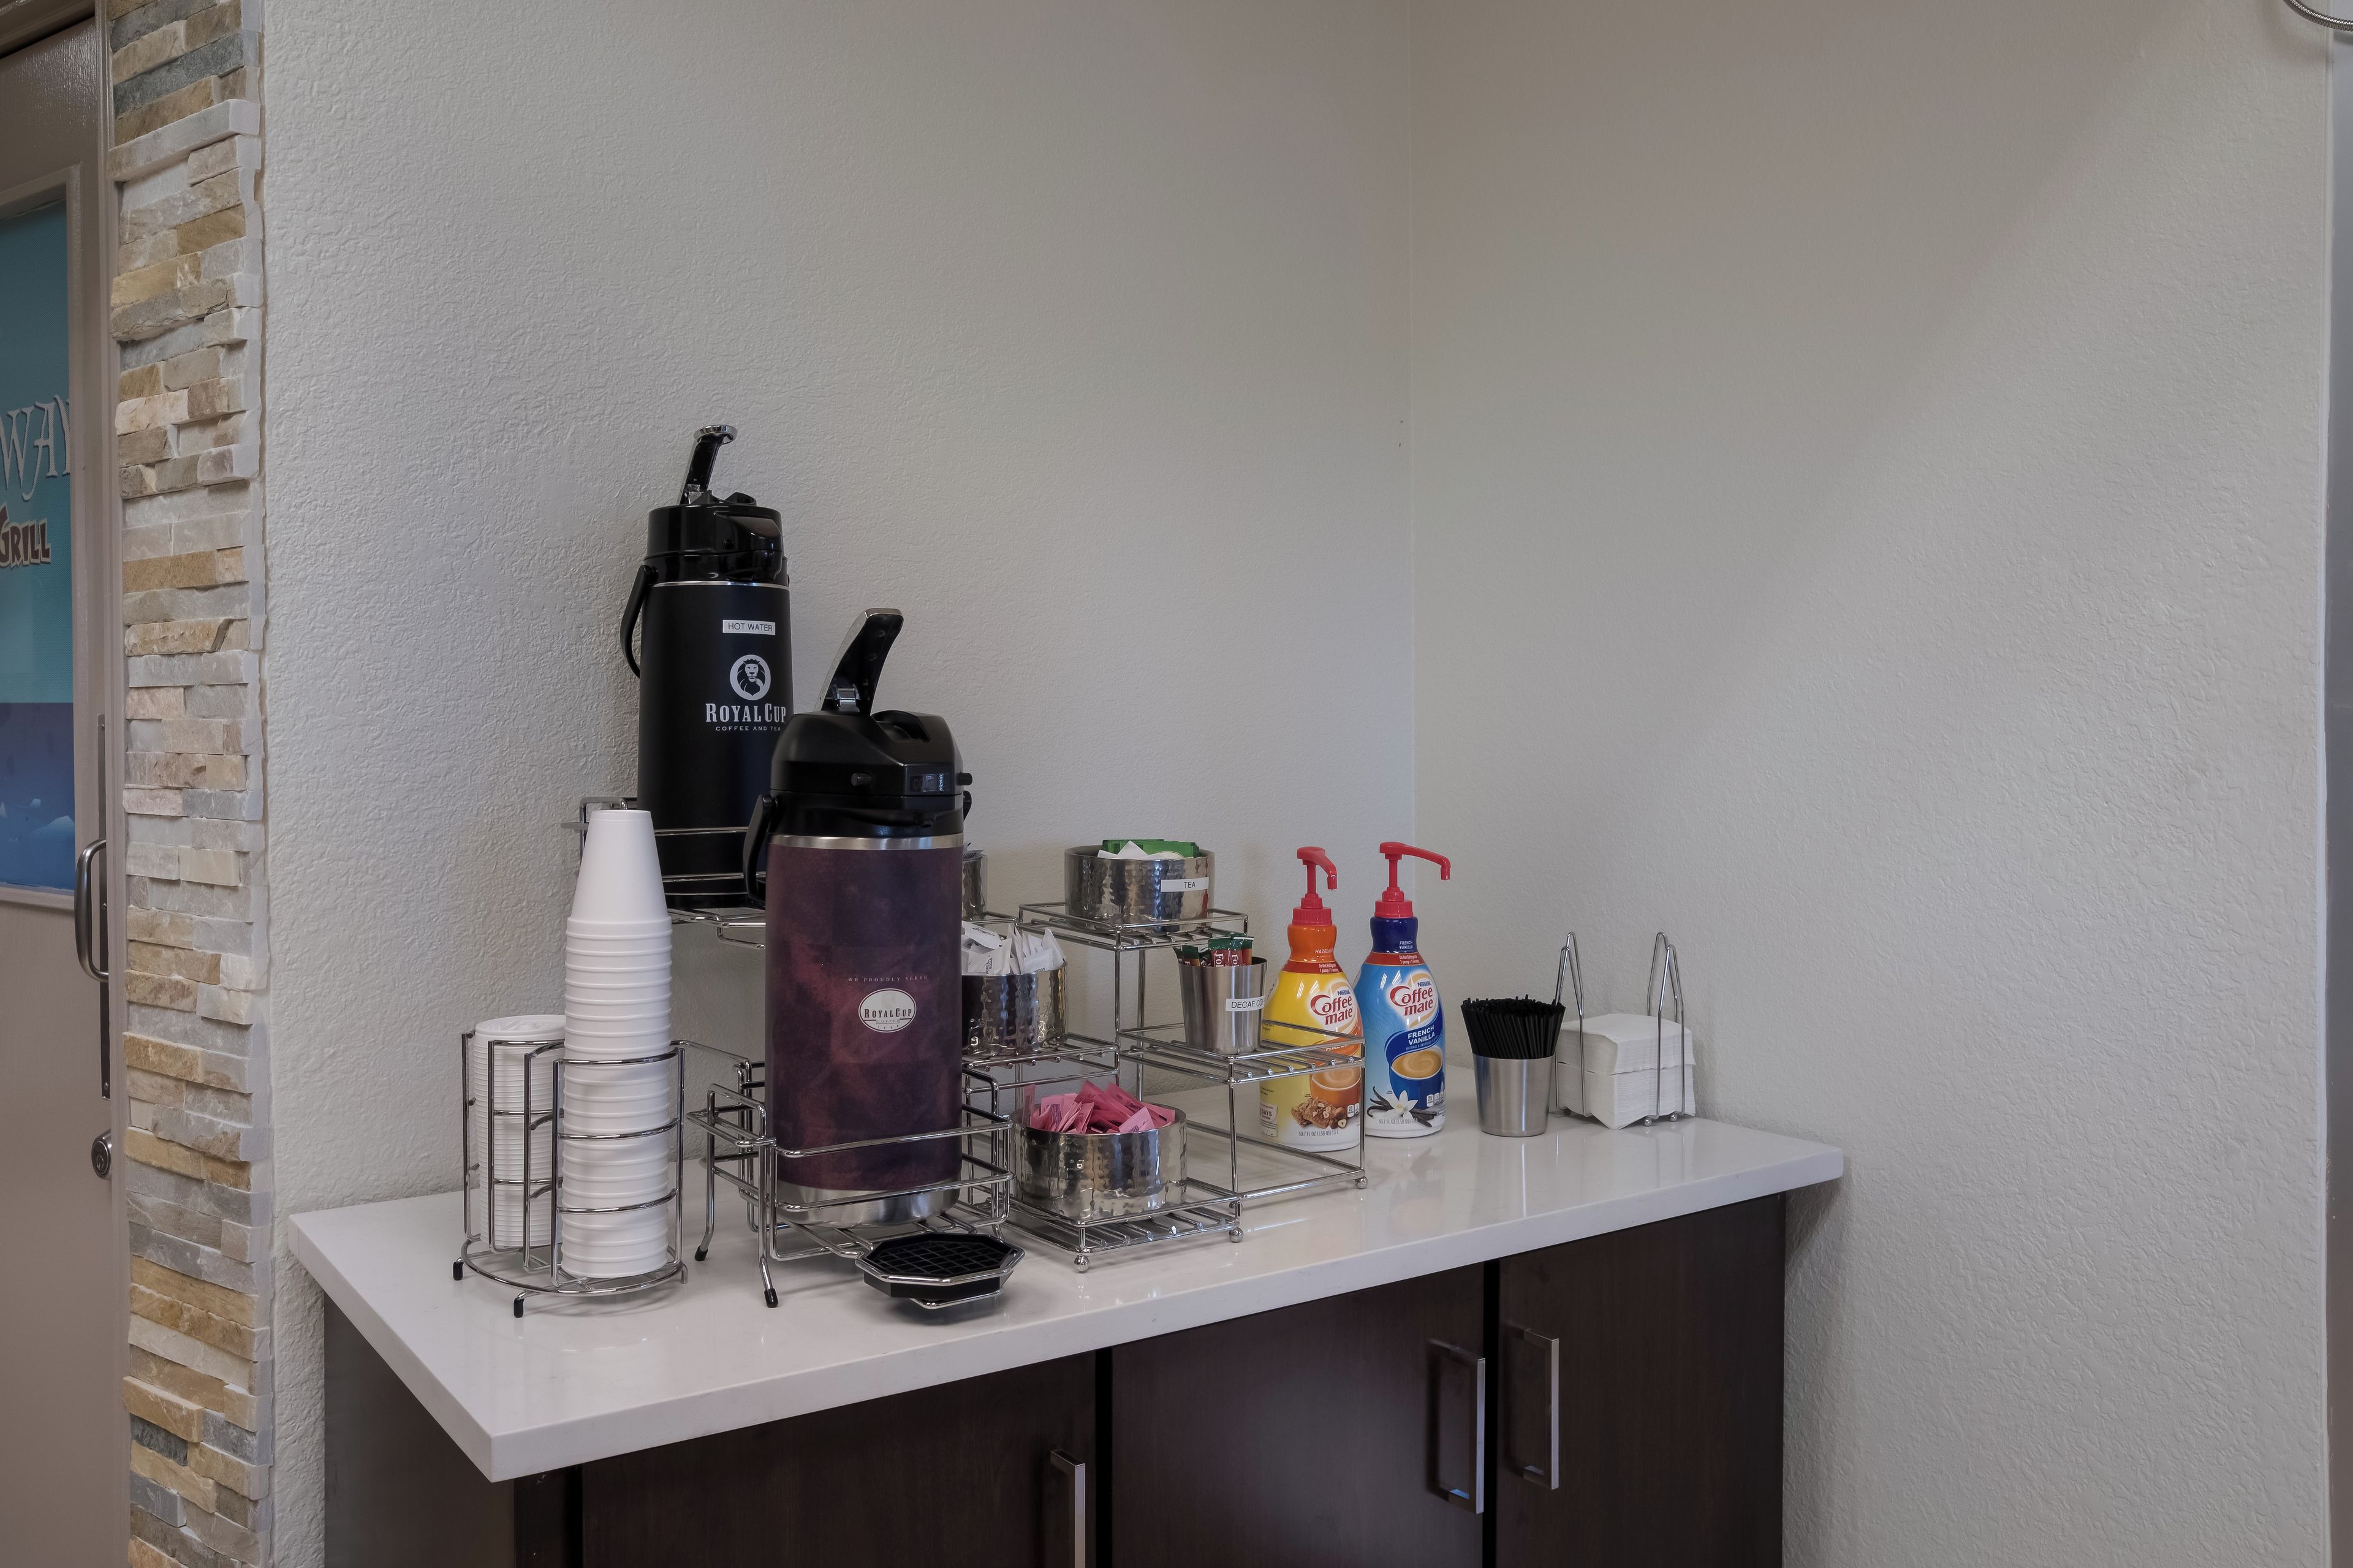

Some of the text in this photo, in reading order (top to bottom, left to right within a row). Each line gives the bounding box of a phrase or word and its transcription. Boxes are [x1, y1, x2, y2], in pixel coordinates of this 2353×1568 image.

[748, 623, 773, 632] WATER
[706, 703, 786, 723] ROYAL CUP
[1310, 994, 1352, 1015] Coffee
[1390, 985, 1433, 1007] Coffee
[1404, 999, 1433, 1016] mate
[1325, 1008, 1352, 1025] mate
[1408, 1025, 1434, 1039] FRENCH
[1408, 1032, 1435, 1045] VANILLA
